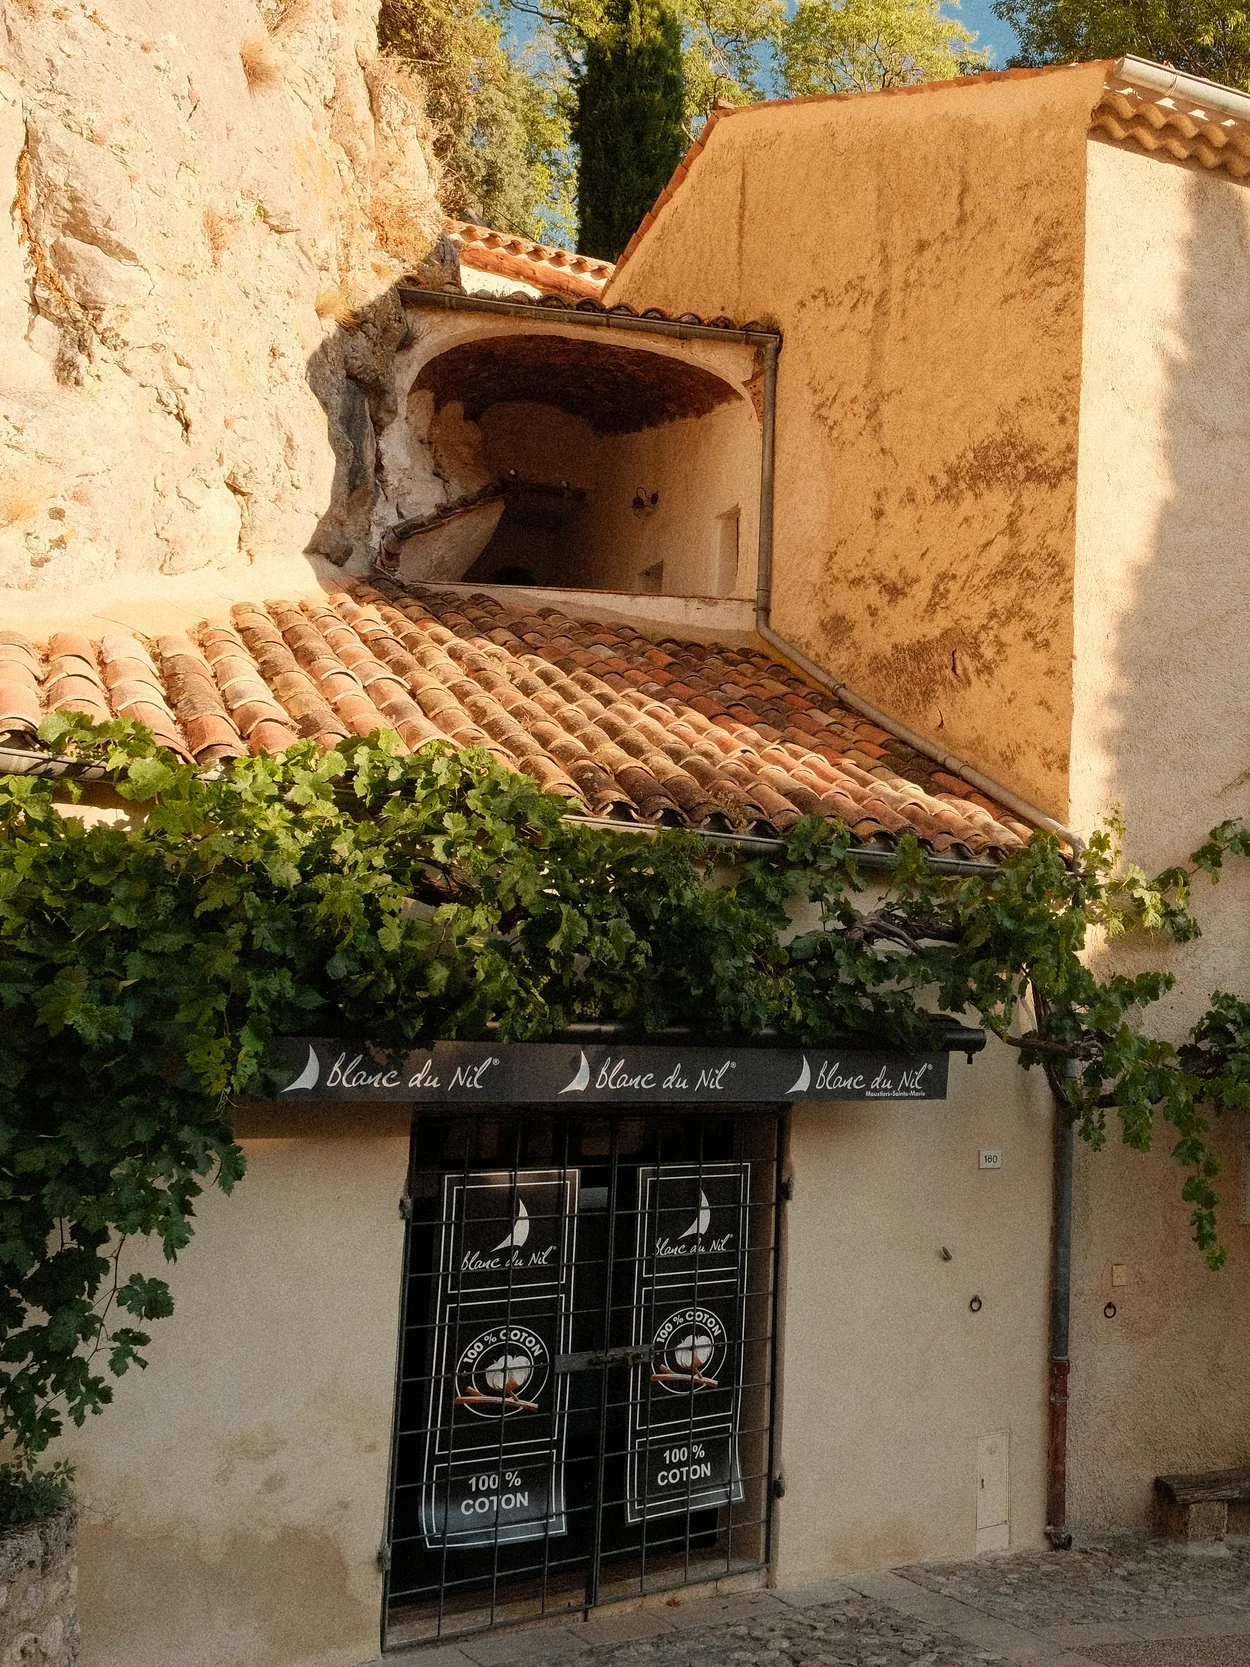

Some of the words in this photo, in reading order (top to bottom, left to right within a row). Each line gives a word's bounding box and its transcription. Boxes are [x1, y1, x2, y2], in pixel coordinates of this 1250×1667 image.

[326, 1051, 401, 1089] Blanc
[408, 1059, 441, 1089] du
[595, 1057, 655, 1090] Blanc
[663, 1063, 690, 1090] du
[815, 1063, 865, 1090] Blanc
[870, 1068, 893, 1090] du
[690, 1237, 706, 1254] du
[460, 1250, 502, 1271] Blanc
[505, 1249, 524, 1267] du
[656, 1322, 673, 1343] 100
[672, 1314, 684, 1325] %
[685, 1311, 722, 1337] COTON
[463, 1342, 484, 1364] 100
[483, 1332, 498, 1345] %
[499, 1329, 544, 1357] COTON
[663, 1447, 688, 1464] 100
[692, 1443, 705, 1459] %
[468, 1474, 499, 1492] 100
[505, 1470, 522, 1488] %
[657, 1462, 711, 1486] COTON
[460, 1491, 529, 1516] COTON
